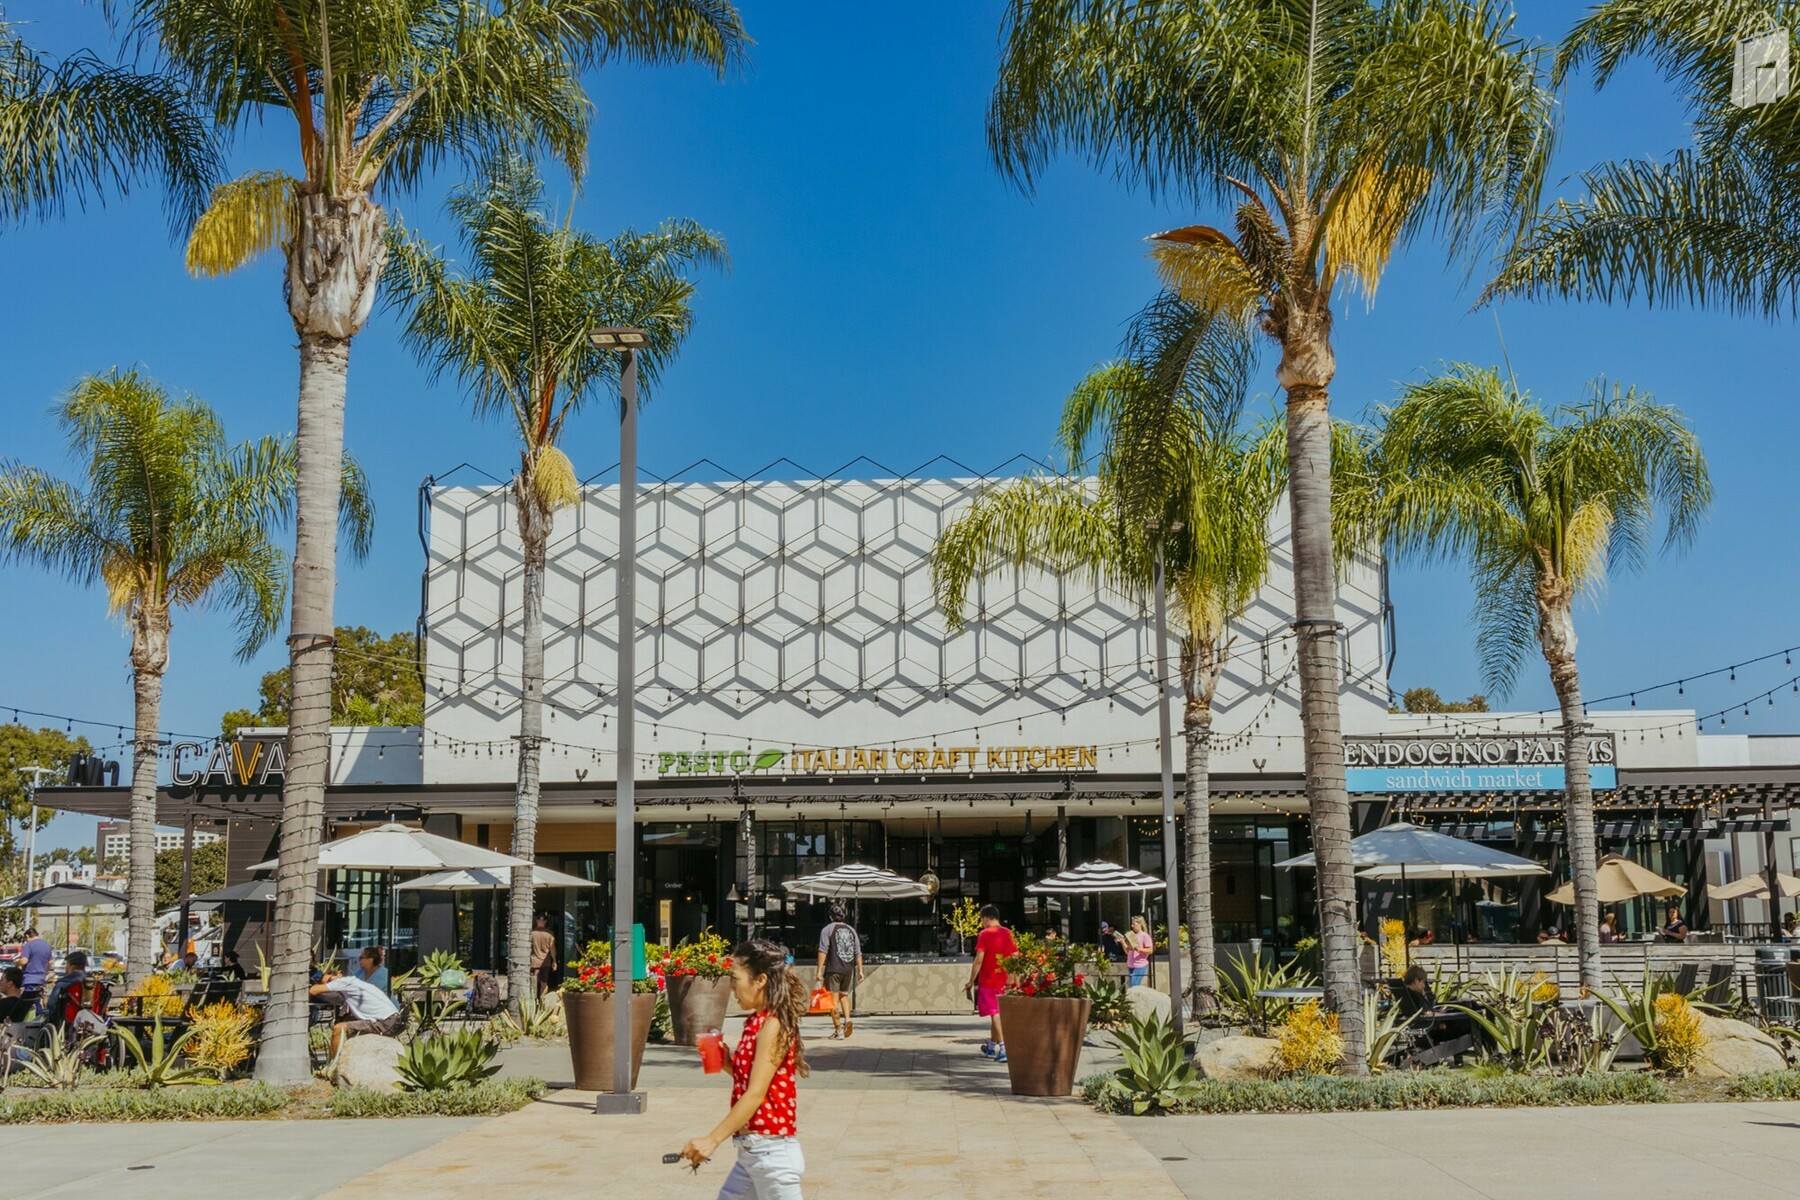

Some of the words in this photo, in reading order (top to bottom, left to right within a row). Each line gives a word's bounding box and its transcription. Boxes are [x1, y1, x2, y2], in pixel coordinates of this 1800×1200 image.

[170, 740, 287, 786] CAVA
[657, 751, 746, 774] PESTO
[790, 748, 888, 771] ITALIAN
[895, 746, 980, 770] CRAFT
[986, 745, 1098, 768] KITCHEN
[1342, 741, 1505, 765] ENDOCINO
[1386, 770, 1472, 789] sandwich
[1477, 769, 1543, 788] market
